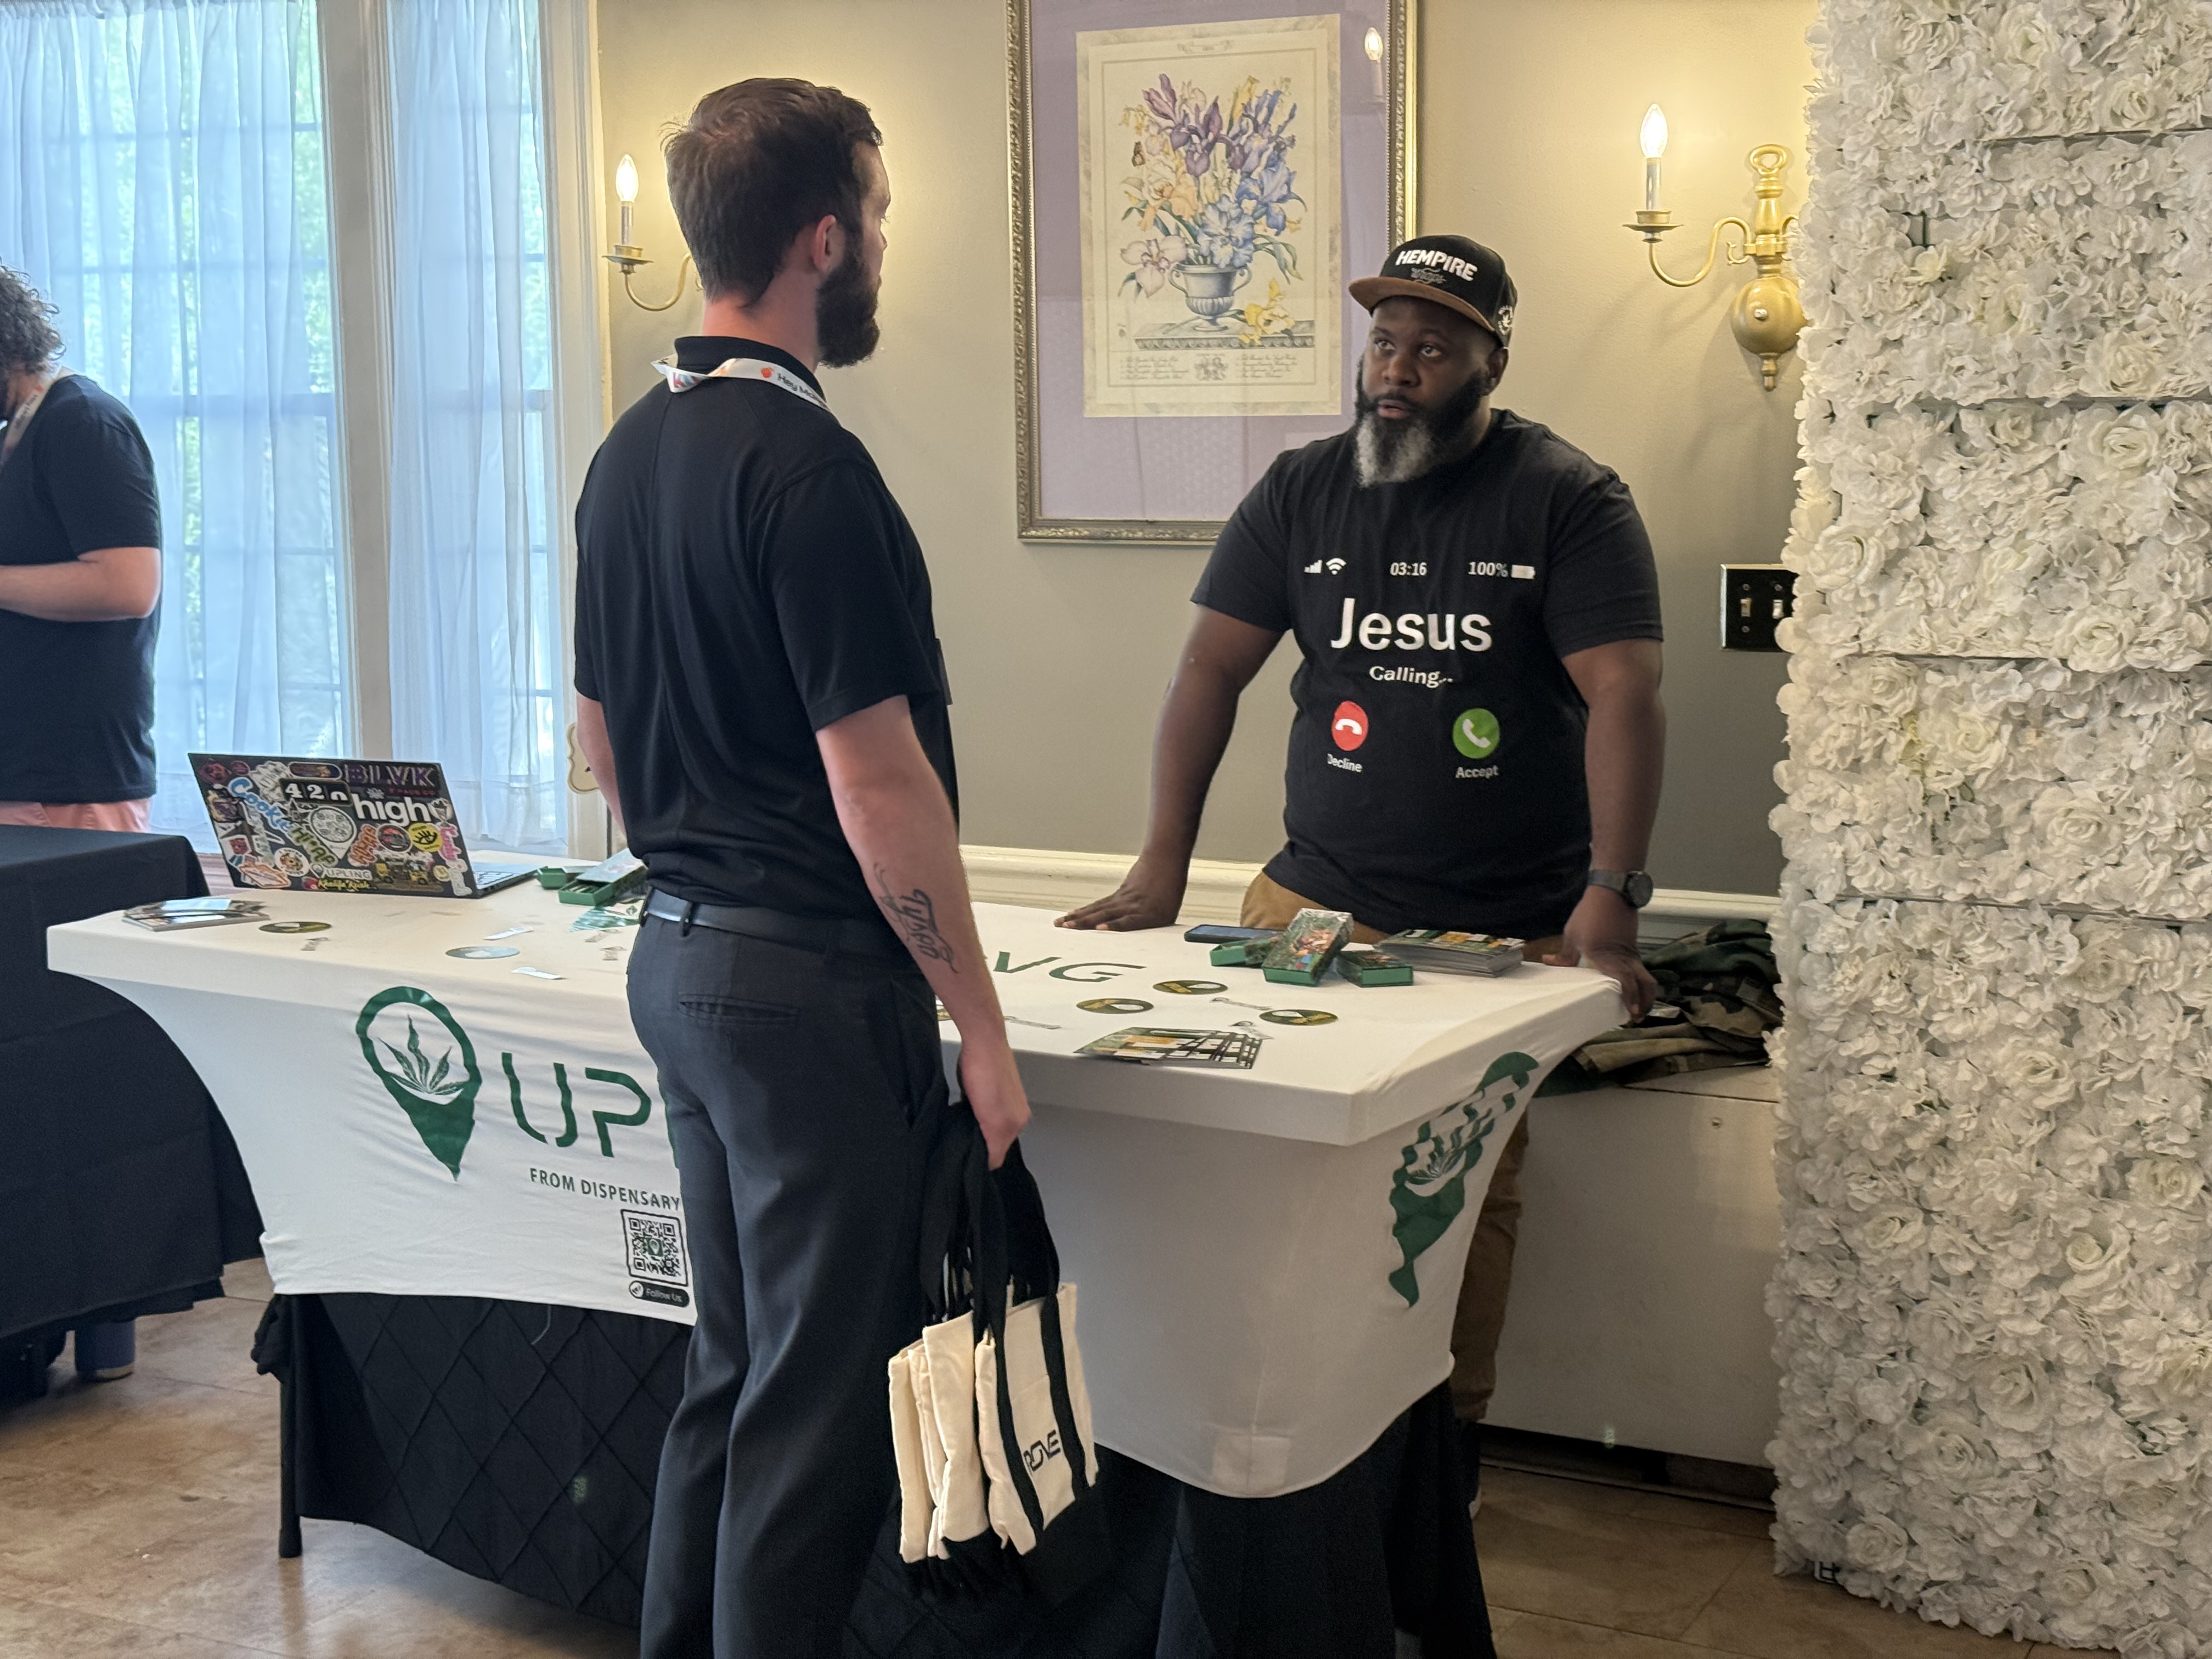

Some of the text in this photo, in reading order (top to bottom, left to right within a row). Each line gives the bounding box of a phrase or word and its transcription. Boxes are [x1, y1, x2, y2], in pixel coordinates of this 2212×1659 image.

[1395, 250, 1478, 281] HEMPIRE
[1390, 561, 1509, 578] 03:16 100%
[1330, 597, 1492, 652] Jesus
[1327, 753, 1363, 773] Decline
[1455, 765, 1499, 779] Accept
[352, 793, 432, 827] high
[325, 868, 370, 879] UPLING
[529, 1167, 680, 1211] FROM DISPENSARY
[646, 1288, 683, 1303] Follow Us
